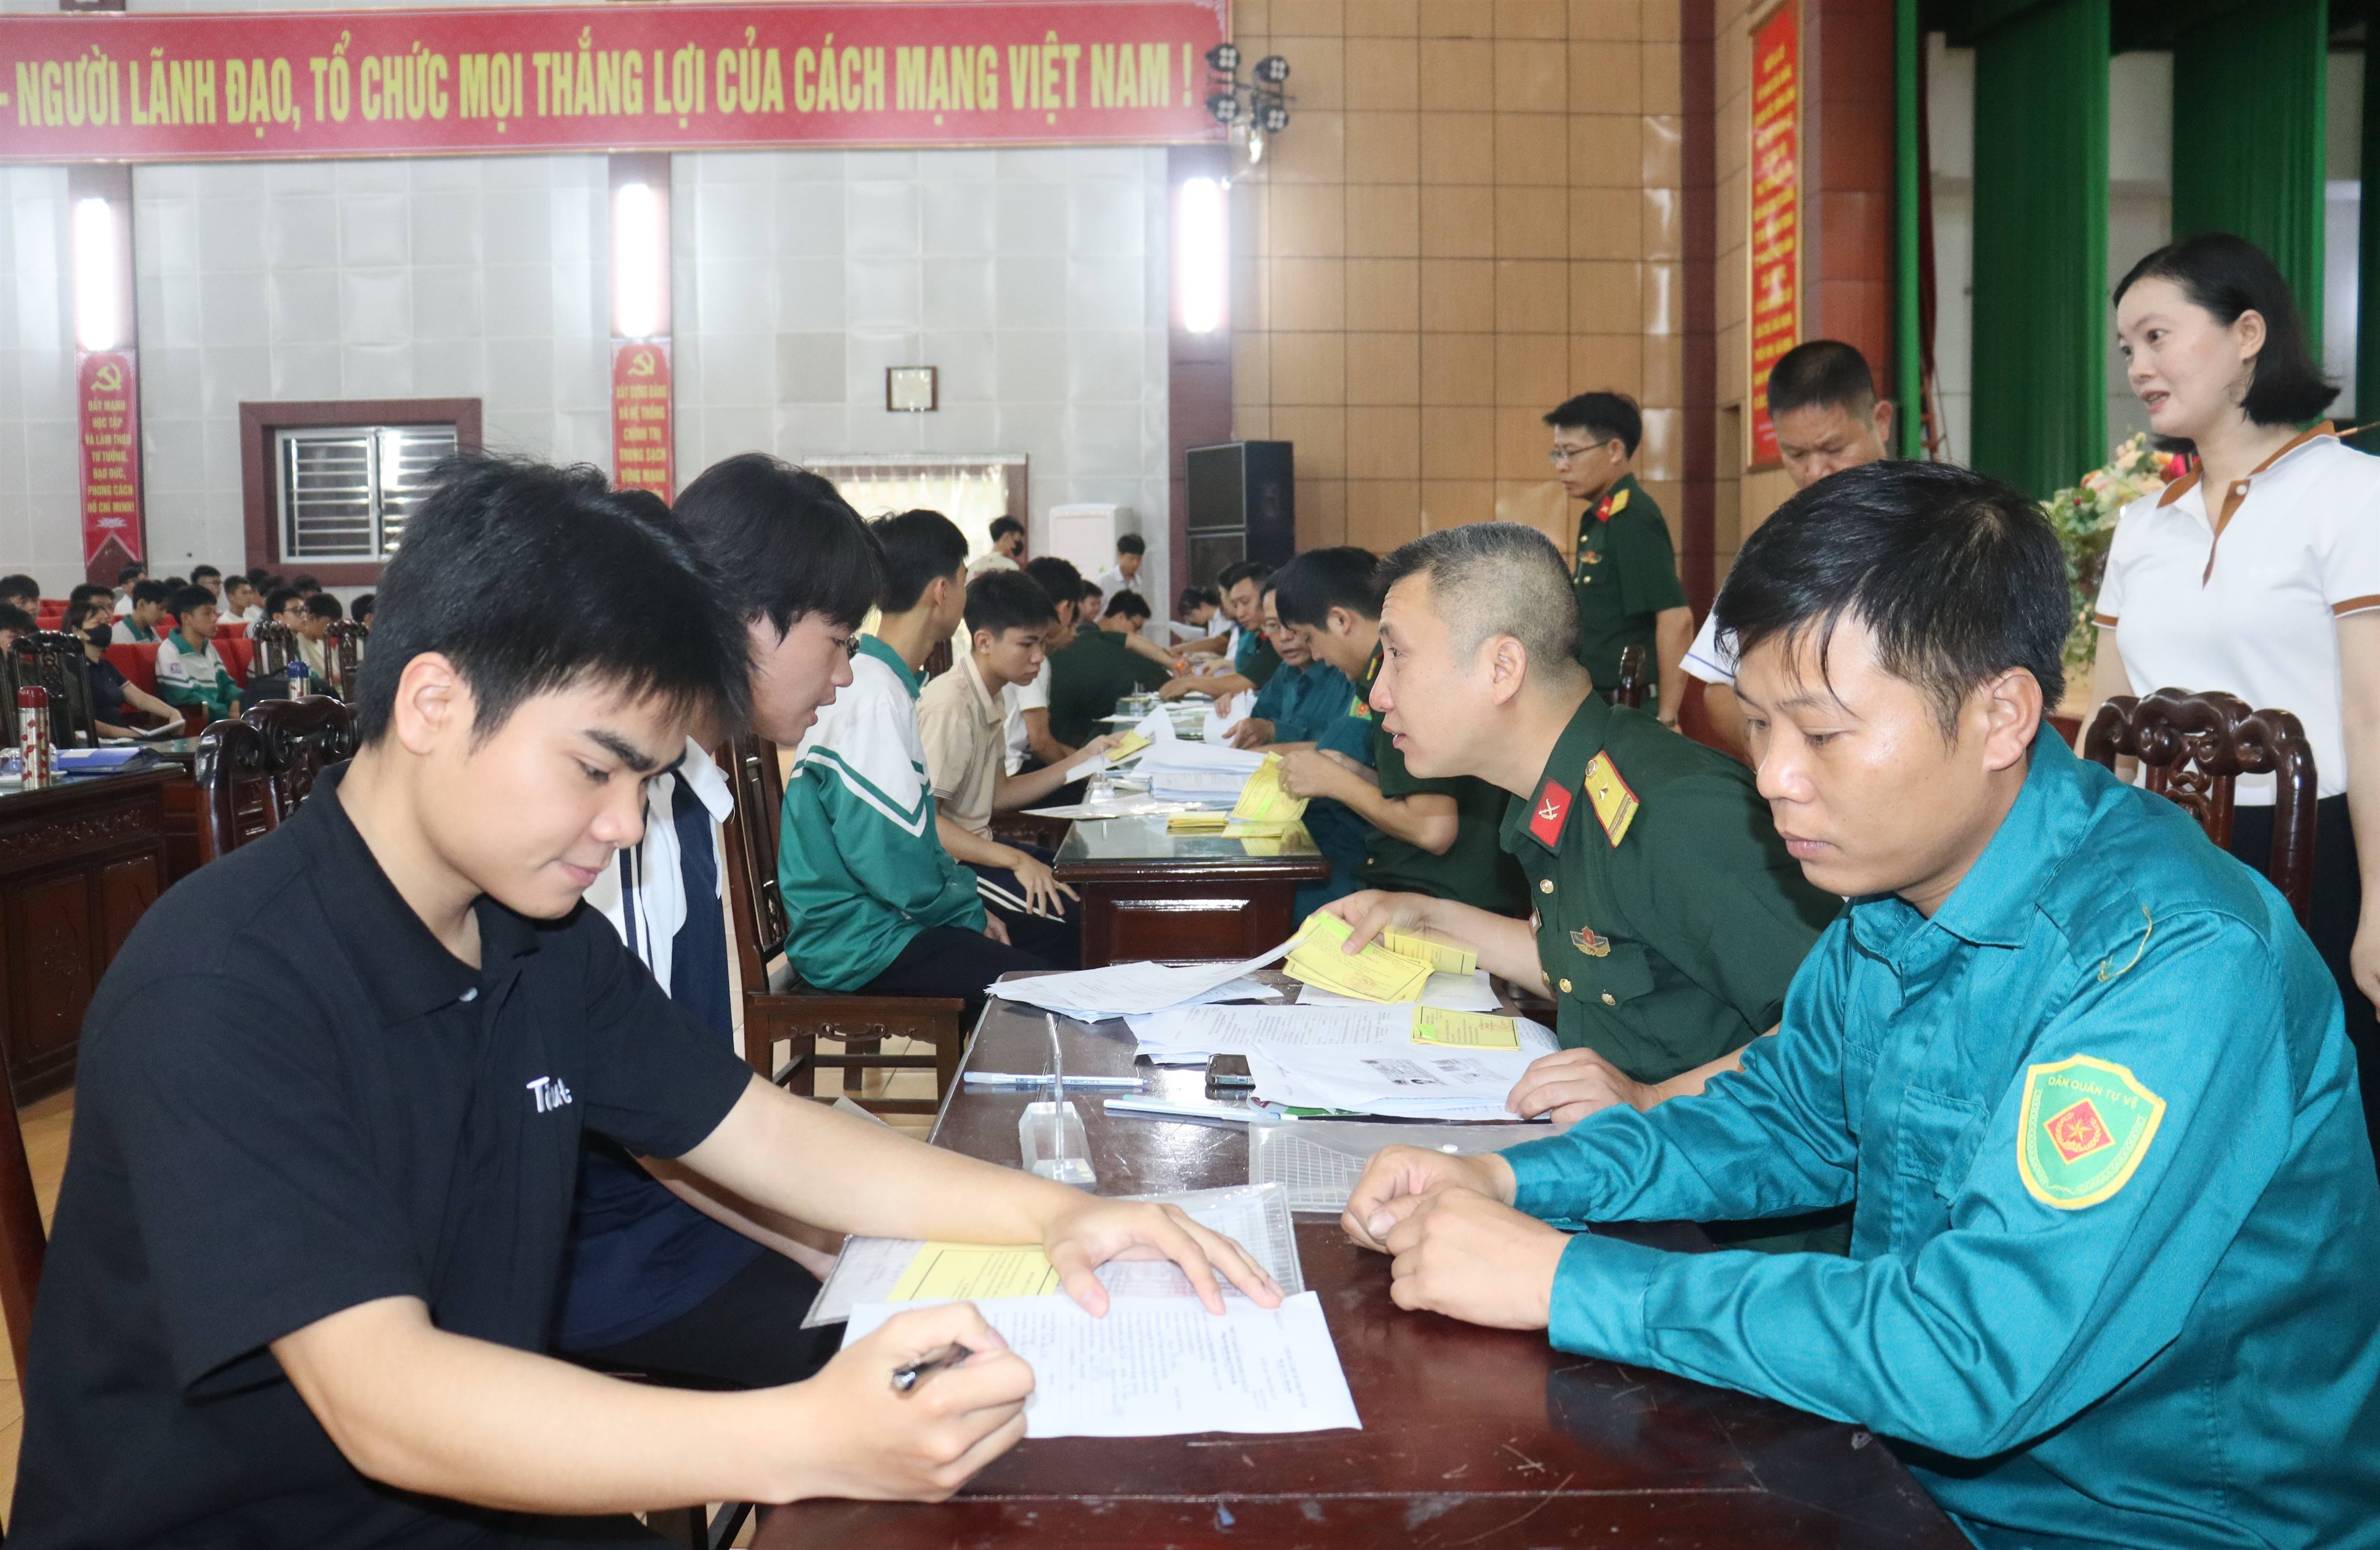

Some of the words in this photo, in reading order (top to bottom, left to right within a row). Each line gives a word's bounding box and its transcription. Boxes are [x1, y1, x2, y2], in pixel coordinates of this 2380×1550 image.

[15, 44, 120, 126] NGƯỜI
[129, 47, 217, 125] LÃNH
[224, 57, 302, 138] ĐẠO,
[309, 30, 352, 122] TỔ
[360, 40, 450, 121] CHỨC
[458, 51, 525, 134] MỌI
[532, 25, 644, 117] THẮNG
[653, 41, 706, 128] LỢI
[715, 24, 786, 116] CỦA
[793, 32, 886, 113] CÁCH
[895, 44, 999, 127] MẠNG
[1007, 30, 1083, 125] VIỆT
[1089, 42, 1171, 109] NAM
[1182, 42, 1193, 106] !
[88, 485, 112, 496] PHONG
[2048, 1074, 2070, 1088] DÂN
[2070, 1079, 2104, 1096] QUÂN
[2105, 1088, 2121, 1103] TỰ
[2123, 1094, 2139, 1110] VỆ
